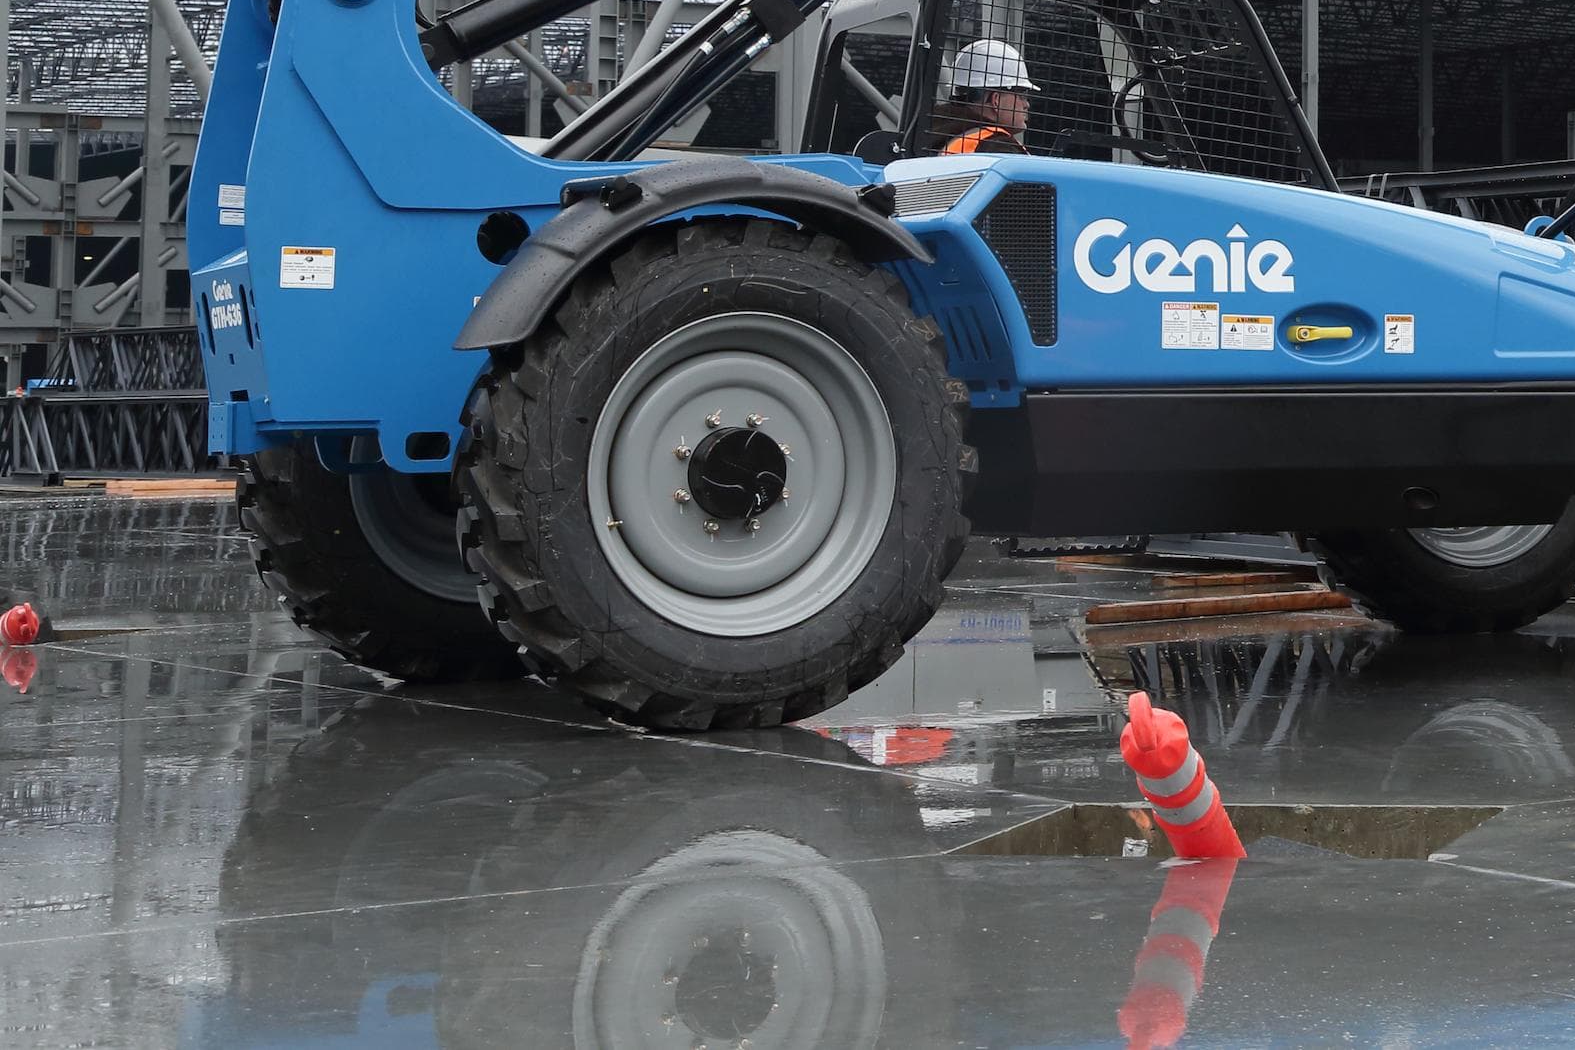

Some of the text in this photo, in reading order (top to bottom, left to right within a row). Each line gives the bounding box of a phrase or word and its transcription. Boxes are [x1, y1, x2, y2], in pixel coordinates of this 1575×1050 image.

[1073, 218, 1295, 294] Genie
[212, 279, 234, 302] Genie
[211, 302, 243, 330] GTH-636
